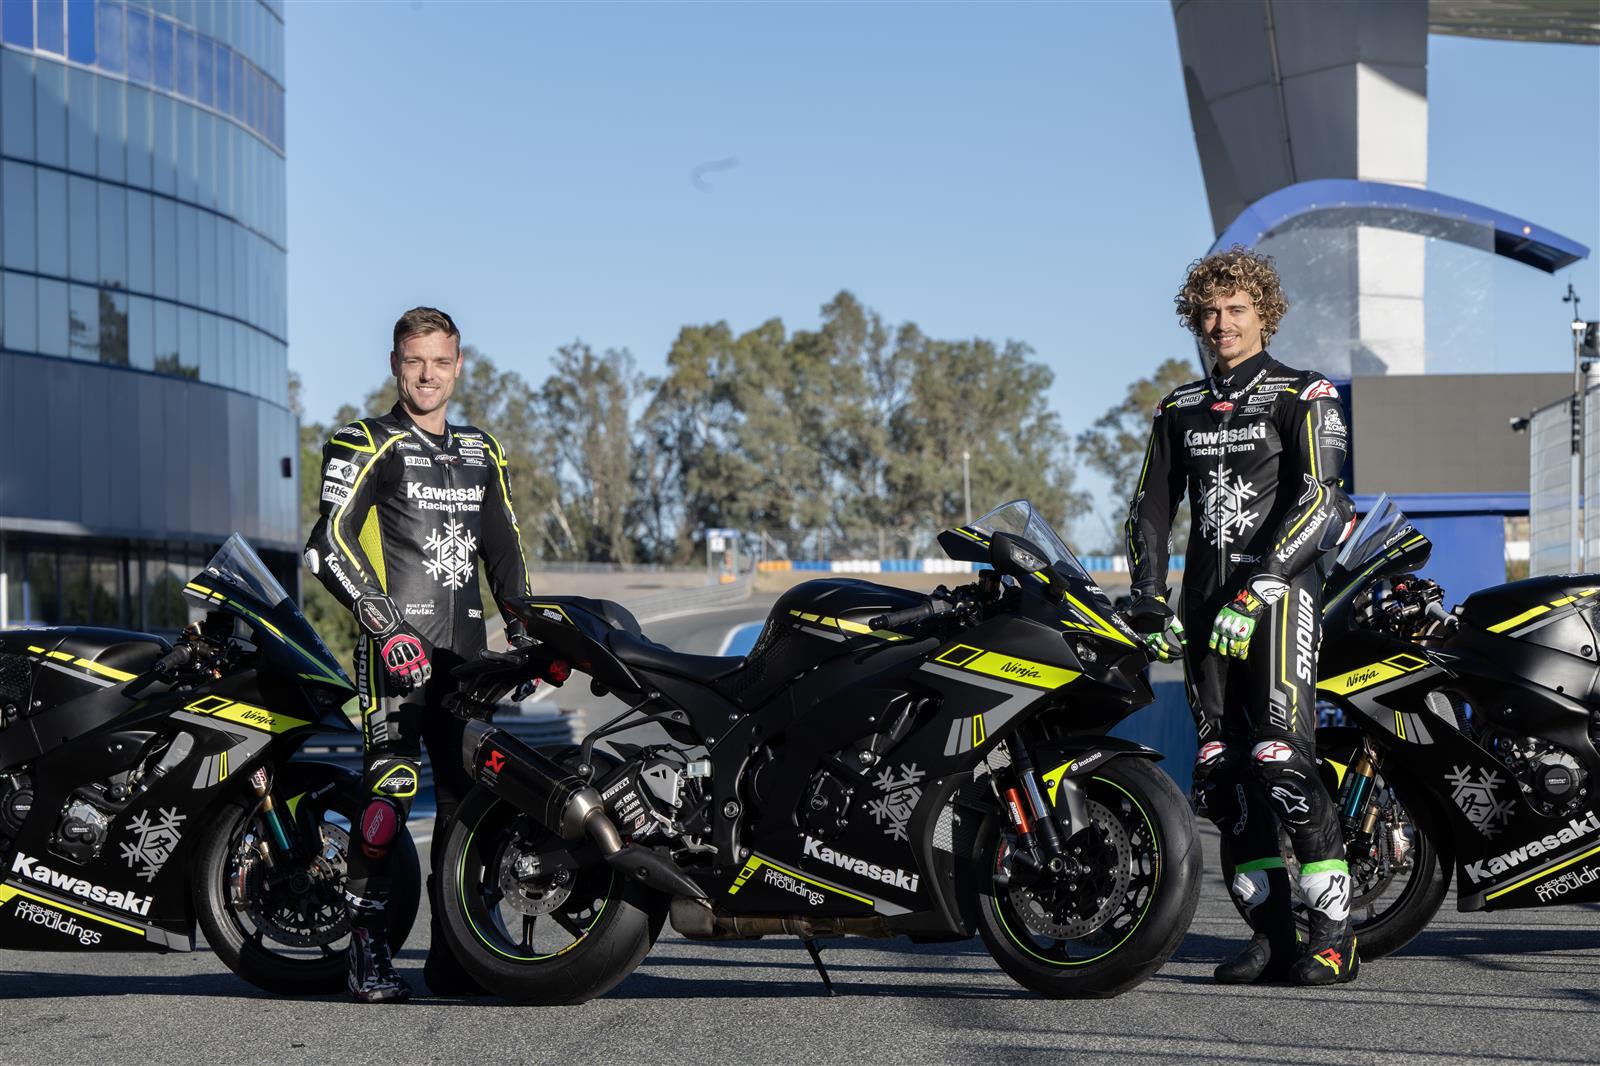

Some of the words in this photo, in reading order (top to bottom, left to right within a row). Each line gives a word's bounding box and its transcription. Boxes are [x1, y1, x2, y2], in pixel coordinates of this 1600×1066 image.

[1179, 394, 1201, 404] SHOEI
[1184, 422, 1266, 447] Kawasaki
[1190, 446, 1225, 457] Racing
[1227, 443, 1256, 453] Team
[414, 457, 430, 466] JUTA
[324, 484, 349, 499] attis
[407, 481, 486, 502] Kawasaki
[418, 500, 456, 513] Racing
[456, 503, 480, 512] Team
[1276, 505, 1328, 563] Kawasaki
[1230, 553, 1262, 563] SBK
[324, 552, 361, 600] Kawasa
[1296, 587, 1314, 686] SHOWA
[1000, 661, 1041, 678] Ninja
[1346, 669, 1379, 688] Ninja
[240, 710, 277, 726] Ninja
[1078, 751, 1102, 767] Insta360
[380, 777, 416, 788] RST
[622, 790, 637, 804] RK
[1464, 810, 1600, 884] Kawasaki
[803, 835, 920, 893] Kawasaki
[11, 851, 153, 916] Kawasaki
[766, 868, 794, 884] CHESHIRE
[1534, 871, 1573, 893] CHESHIRE
[1537, 865, 1600, 903] mouldin
[764, 874, 825, 906] mouldings
[18, 900, 60, 920] CHESHIRE
[14, 905, 103, 945] mouldings
